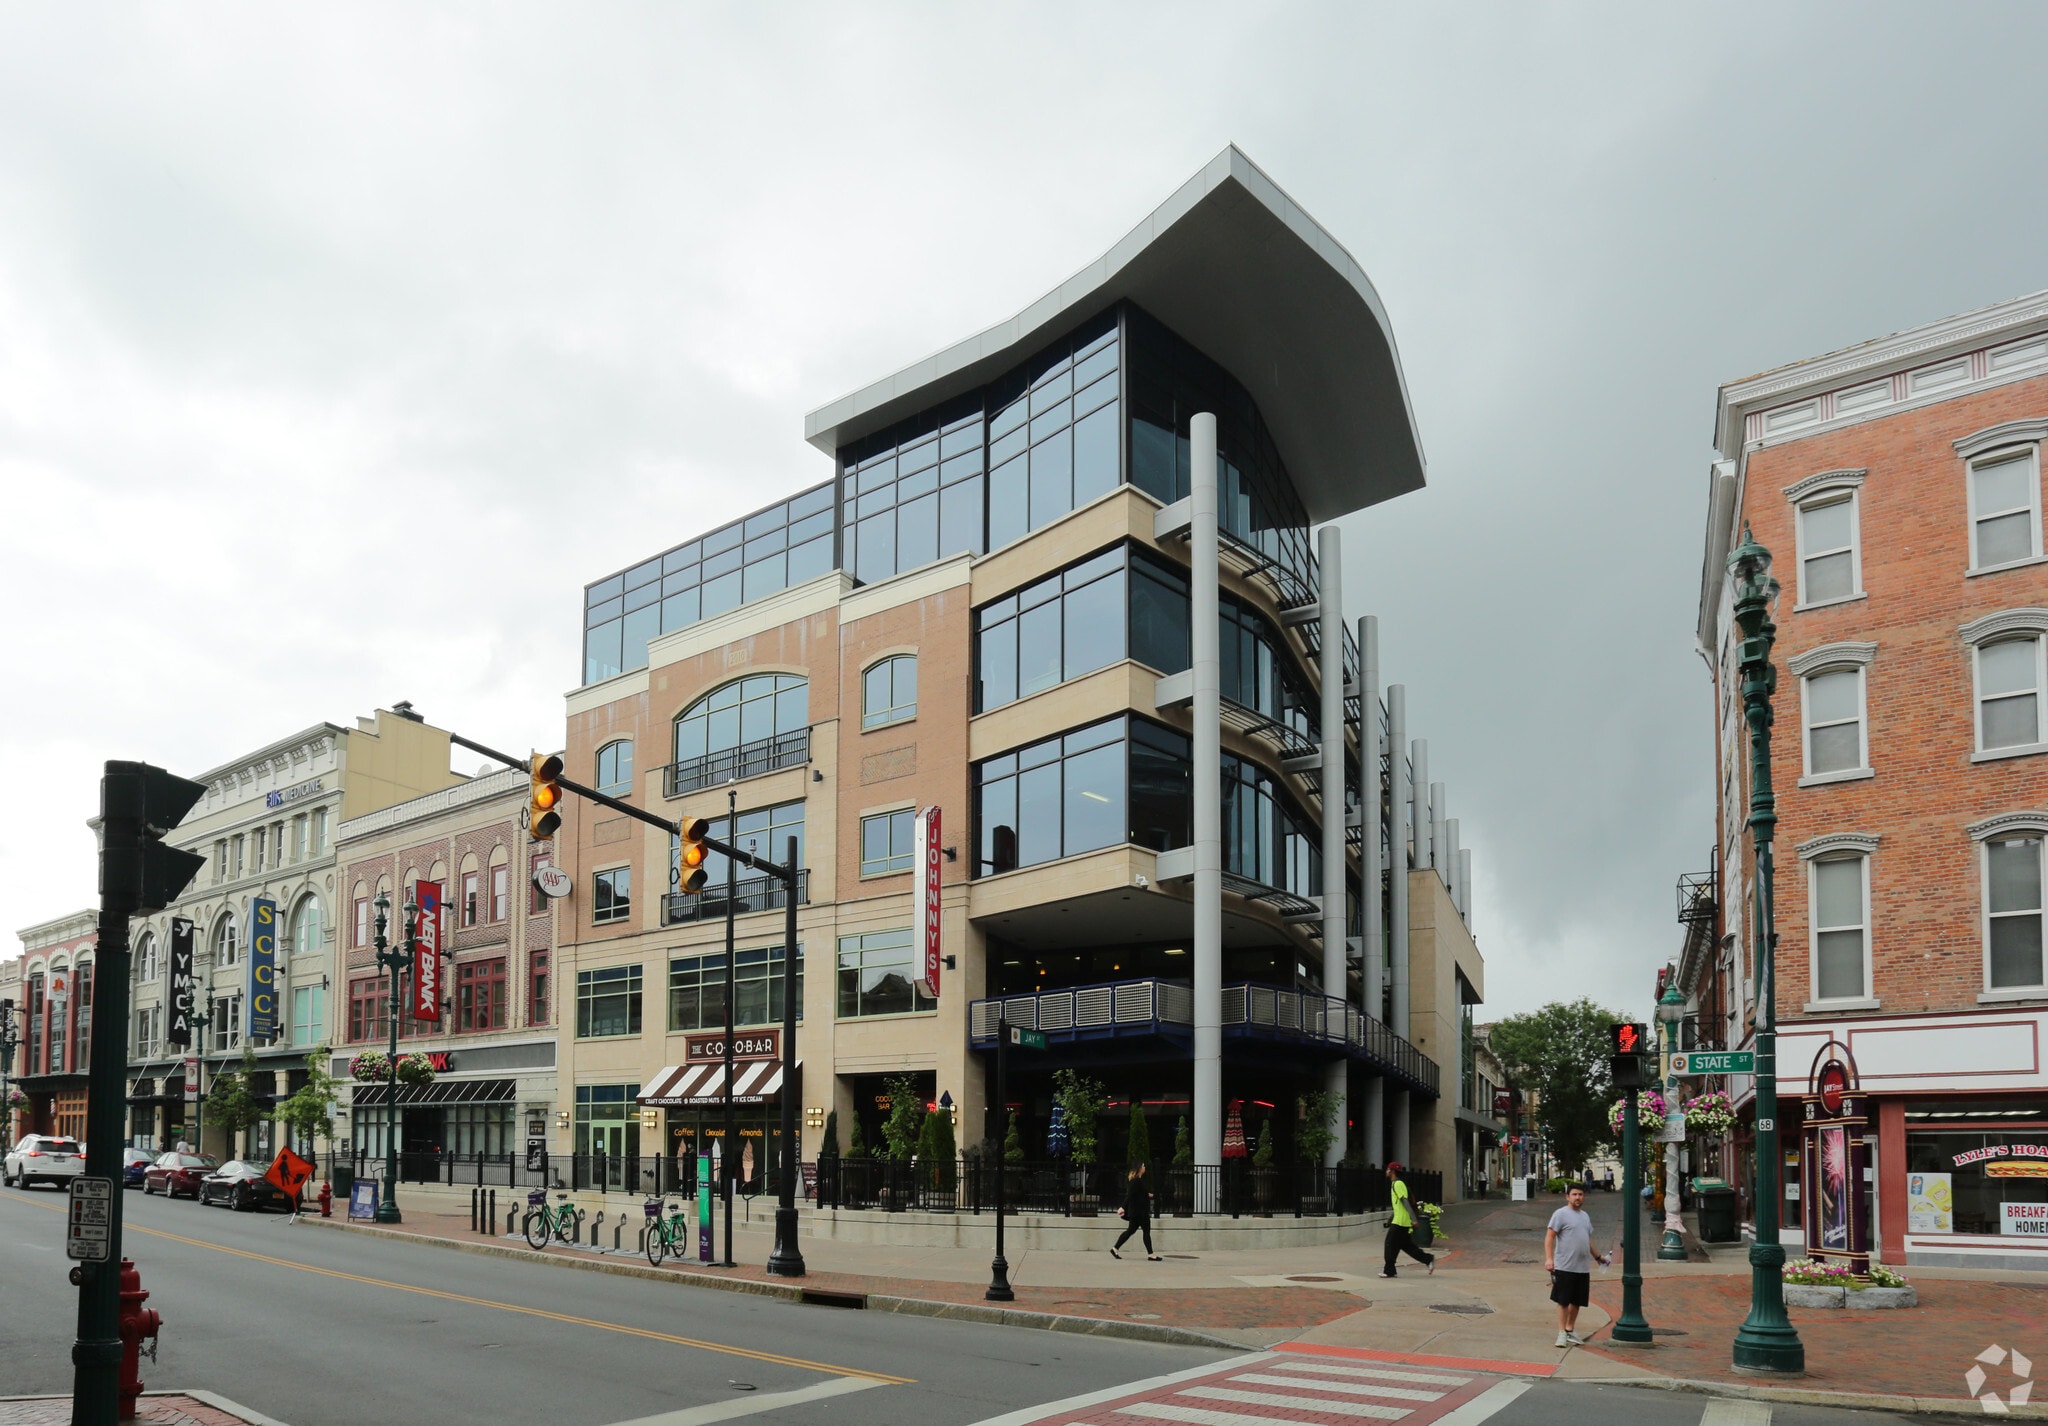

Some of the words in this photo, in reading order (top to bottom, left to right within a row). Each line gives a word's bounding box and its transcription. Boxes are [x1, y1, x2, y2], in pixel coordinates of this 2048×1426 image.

[285, 779, 322, 801] MEDICINE
[543, 871, 560, 887] AAA
[422, 908, 436, 955] NBT
[254, 905, 273, 1014] SCCC
[174, 952, 189, 1031] YMCA
[420, 955, 436, 1014] BANK
[1025, 1033, 1036, 1044] JAY
[1695, 1055, 1732, 1069] STATE
[1738, 1055, 1748, 1063] ST
[674, 1128, 695, 1137] Coffee
[739, 1128, 763, 1137] Almonds
[1760, 1119, 1771, 1130] 68
[1953, 1145, 2008, 1166] LYLE'S
[2007, 1206, 2048, 1218] BREAKF
